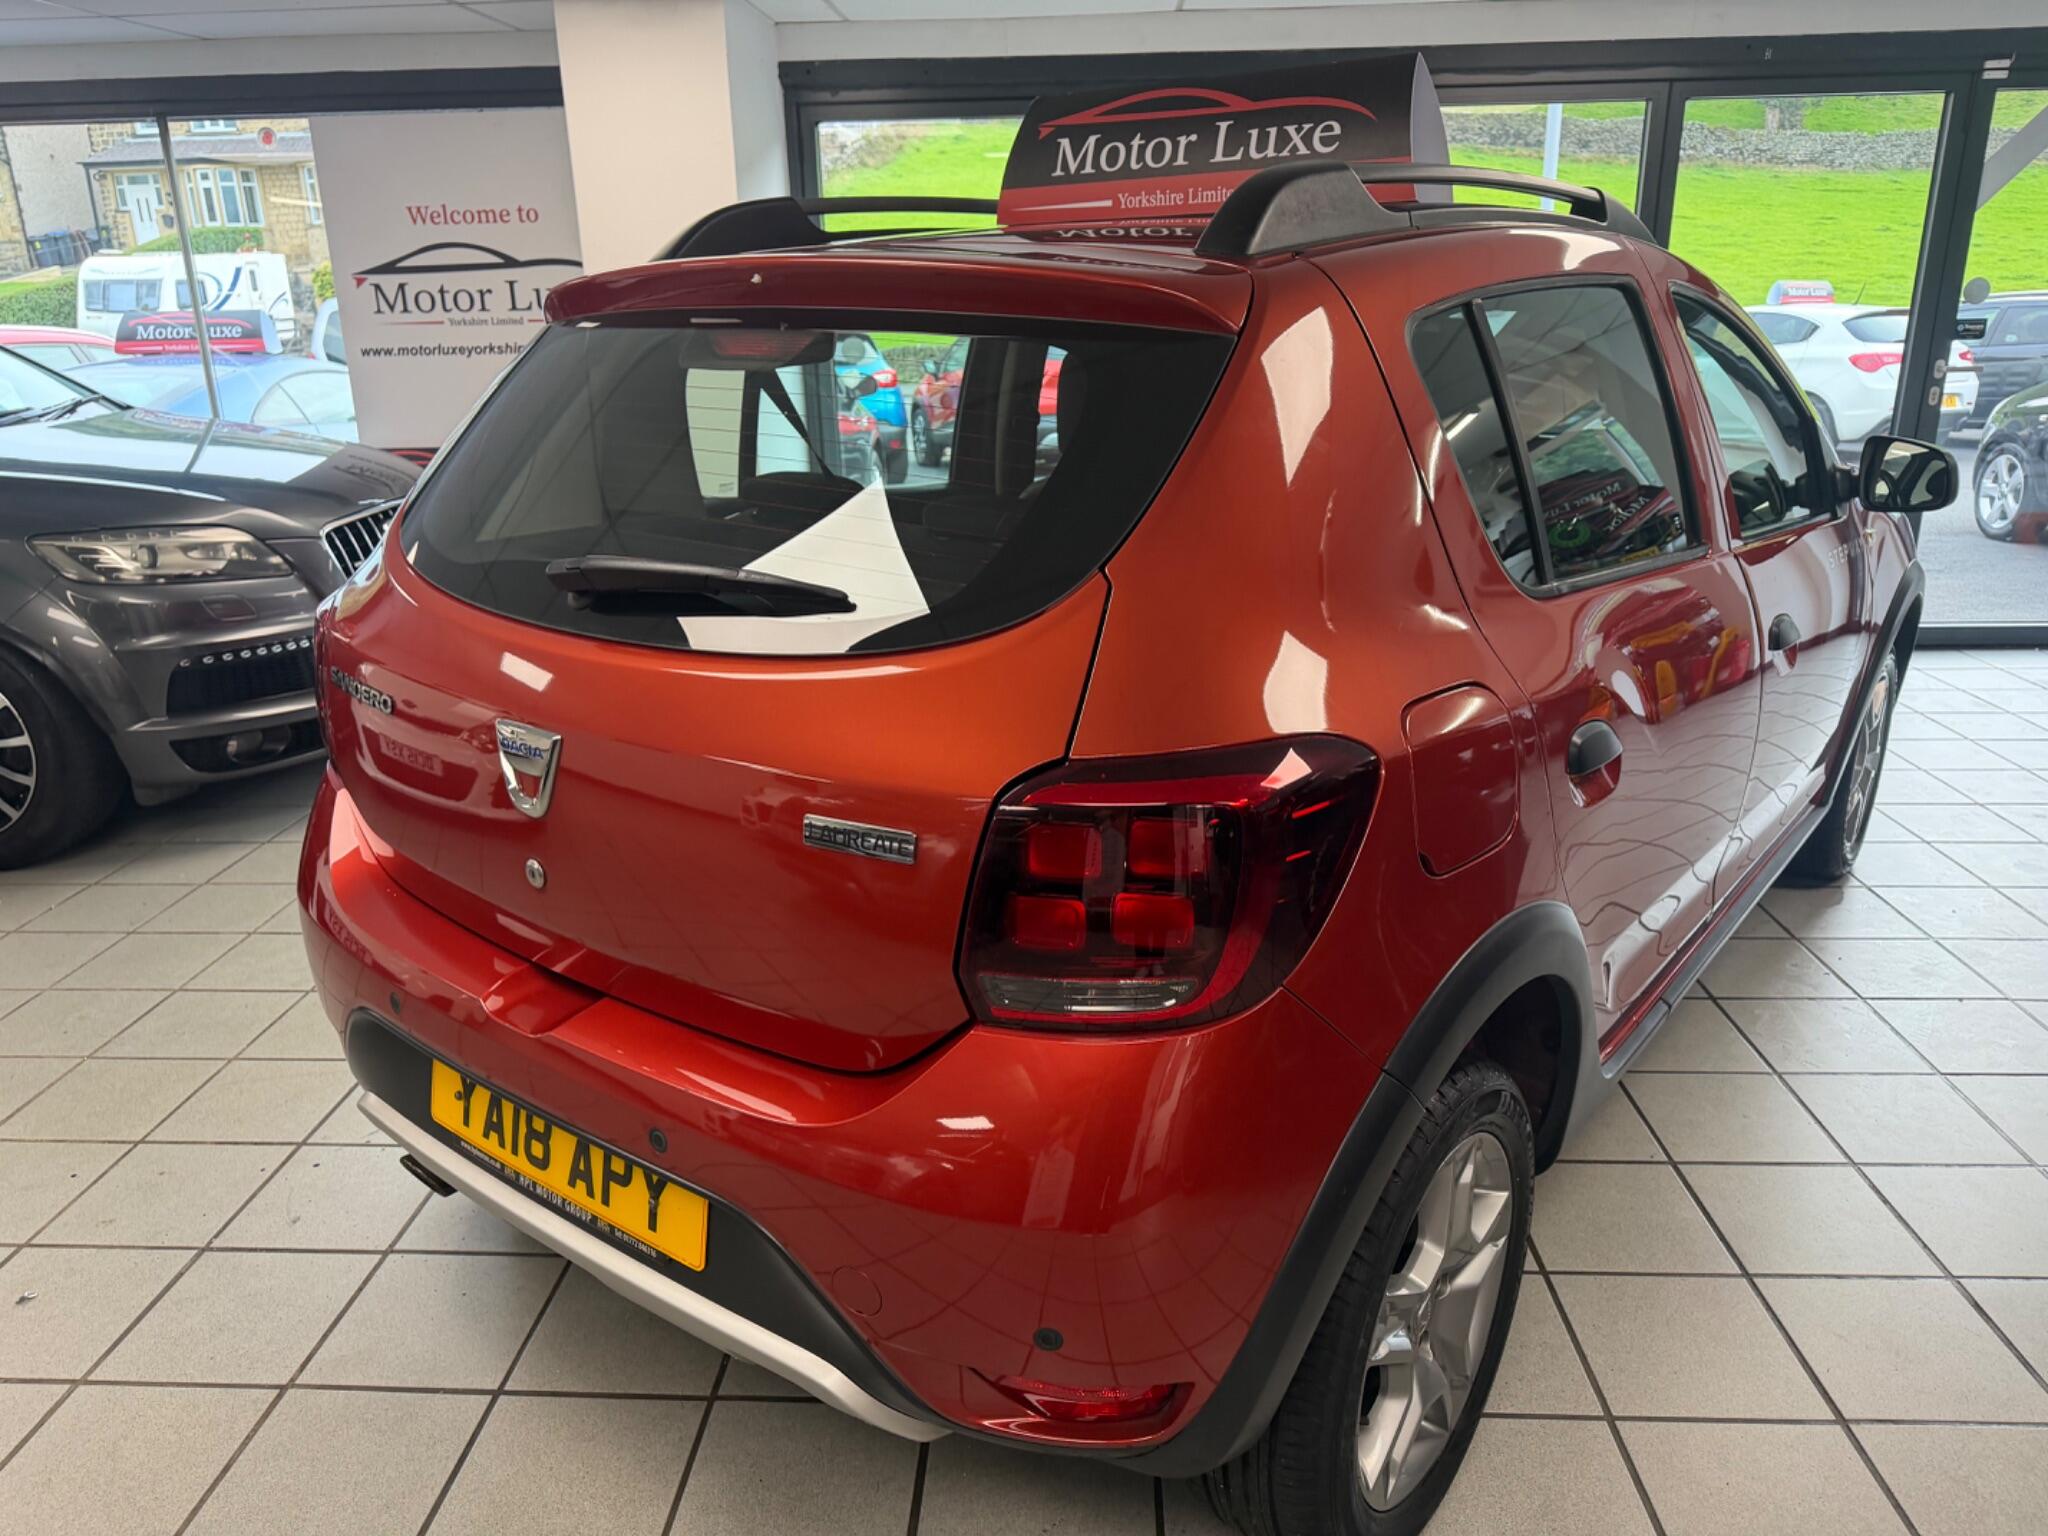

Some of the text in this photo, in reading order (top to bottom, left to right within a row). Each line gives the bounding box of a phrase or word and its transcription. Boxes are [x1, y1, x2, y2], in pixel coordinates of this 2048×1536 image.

[1051, 119, 1342, 177] Motor Luxe
[1118, 189, 1184, 209] Yorkshire
[406, 204, 539, 225] Welcome to
[370, 281, 493, 314] Motor
[136, 324, 193, 340] Motor
[448, 316, 524, 327] Yorkshire Limited
[360, 341, 525, 358] www.motorluxeyorkshir
[501, 736, 544, 760] DACIA
[804, 820, 913, 857] LAUREATE
[459, 1074, 668, 1233] YA18 APY
